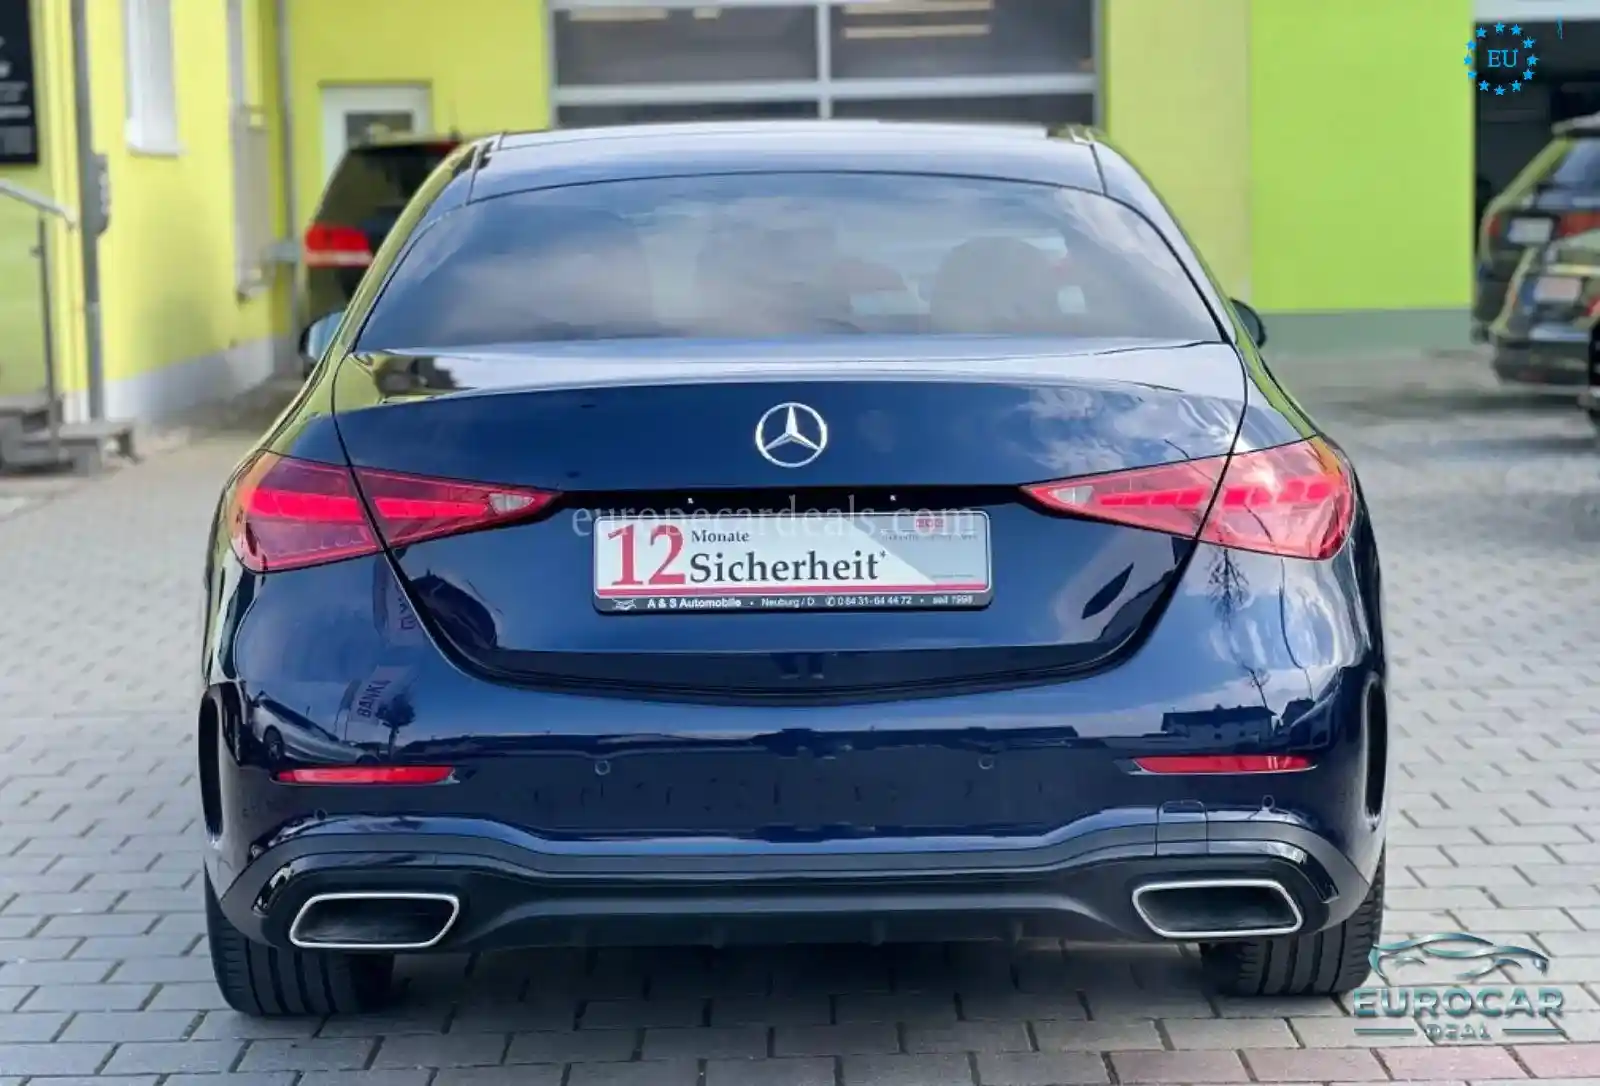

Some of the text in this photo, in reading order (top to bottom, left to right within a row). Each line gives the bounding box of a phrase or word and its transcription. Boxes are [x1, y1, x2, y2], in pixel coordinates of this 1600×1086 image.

[691, 530, 750, 543] Monate
[607, 524, 686, 585] 12
[647, 596, 742, 609] A & S Automobile
[761, 597, 800, 609] Neuburg
